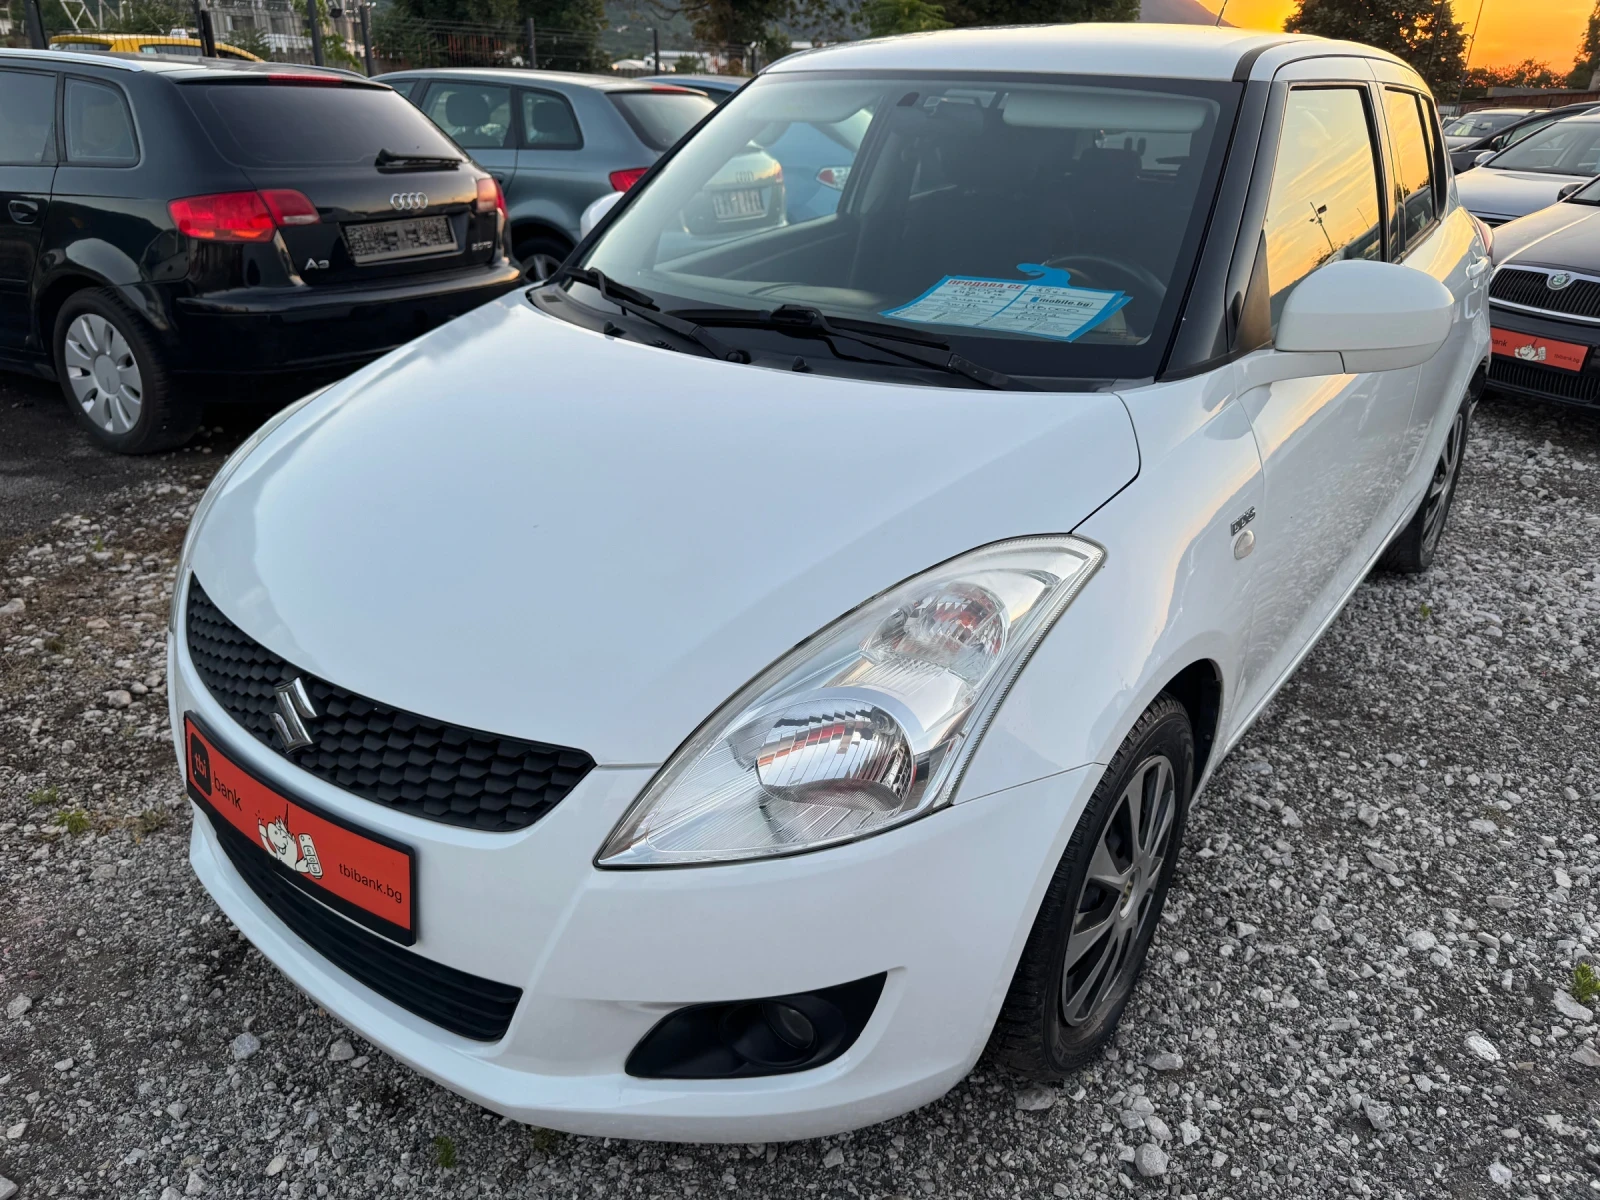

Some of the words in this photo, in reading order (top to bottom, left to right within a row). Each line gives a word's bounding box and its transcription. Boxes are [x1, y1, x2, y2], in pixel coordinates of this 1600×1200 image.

[304, 257, 330, 271] A3
[947, 279, 1004, 289] ПРОДАВА
[194, 754, 207, 777] tbi
[213, 771, 243, 812] bank
[338, 863, 403, 904] tbibank.bg
